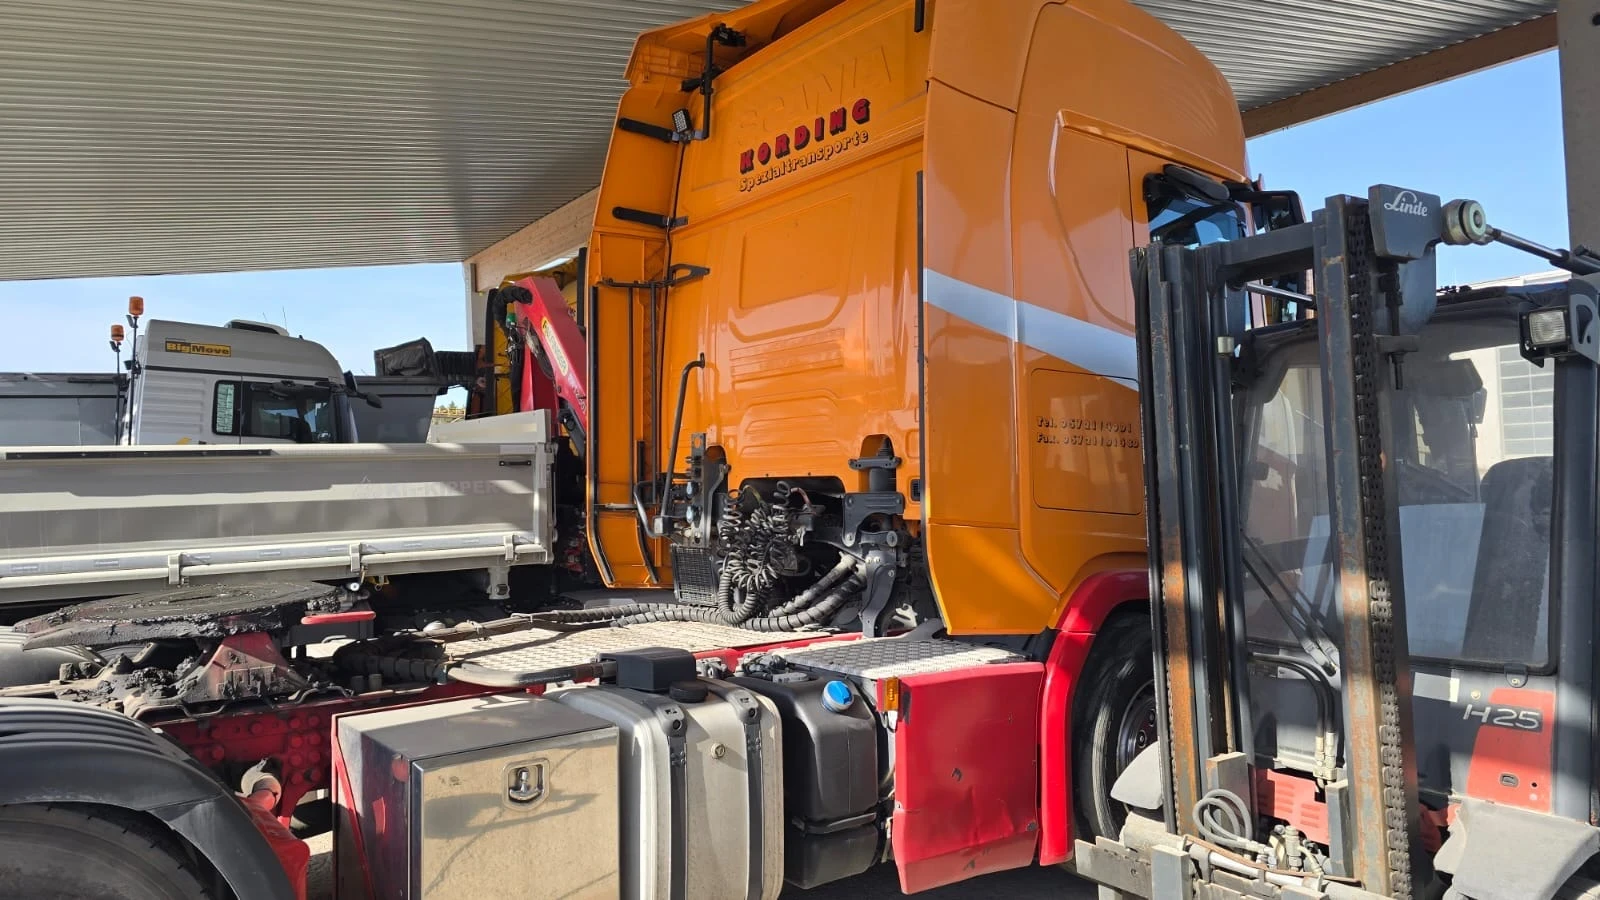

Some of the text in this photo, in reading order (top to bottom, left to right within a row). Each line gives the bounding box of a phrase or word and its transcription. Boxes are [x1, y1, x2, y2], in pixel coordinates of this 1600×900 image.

[740, 98, 871, 175] KORDING
[739, 130, 869, 192] Spezialtransporte
[1384, 190, 1428, 217] Linde
[166, 342, 230, 356] BigMove
[1037, 416, 1058, 429] Tel.
[1463, 704, 1540, 729] H25
